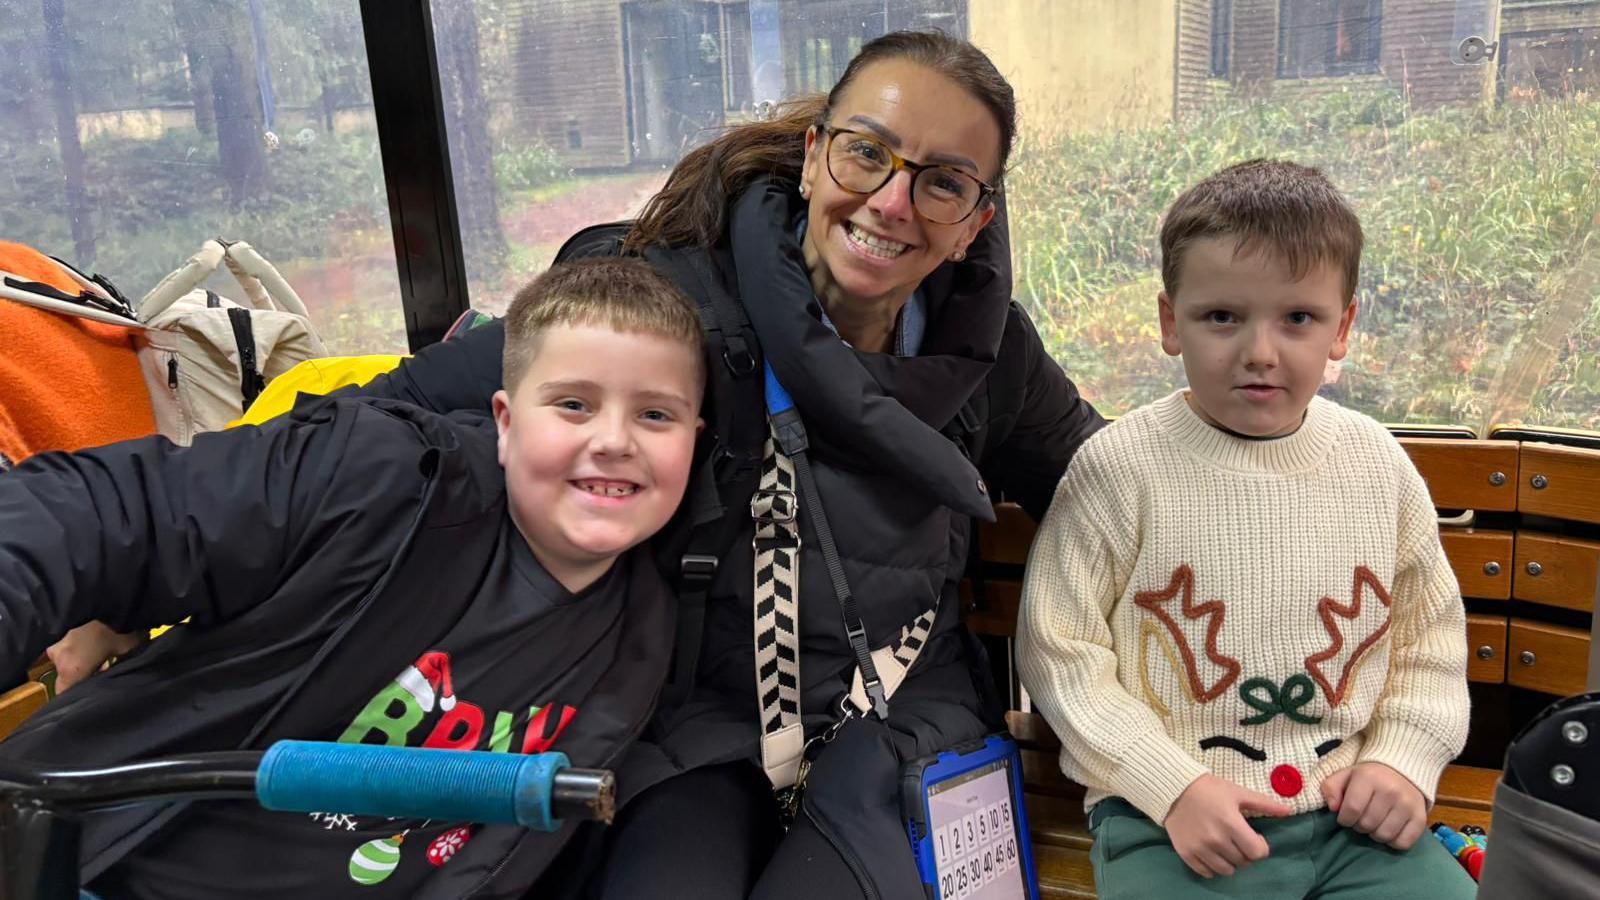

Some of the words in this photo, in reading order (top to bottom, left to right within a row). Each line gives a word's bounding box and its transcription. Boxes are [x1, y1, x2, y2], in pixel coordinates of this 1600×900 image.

[939, 834, 945, 857] 1
[953, 828, 961, 849] 2
[967, 821, 974, 842] 3
[980, 815, 986, 835] 5
[989, 809, 999, 830] 10
[1001, 803, 1010, 824] 15
[942, 873, 954, 899] 20
[956, 865, 968, 890] 25
[970, 858, 981, 882] 30
[983, 851, 993, 873] 40
[996, 844, 1004, 864] 45
[1006, 838, 1016, 860] 60
